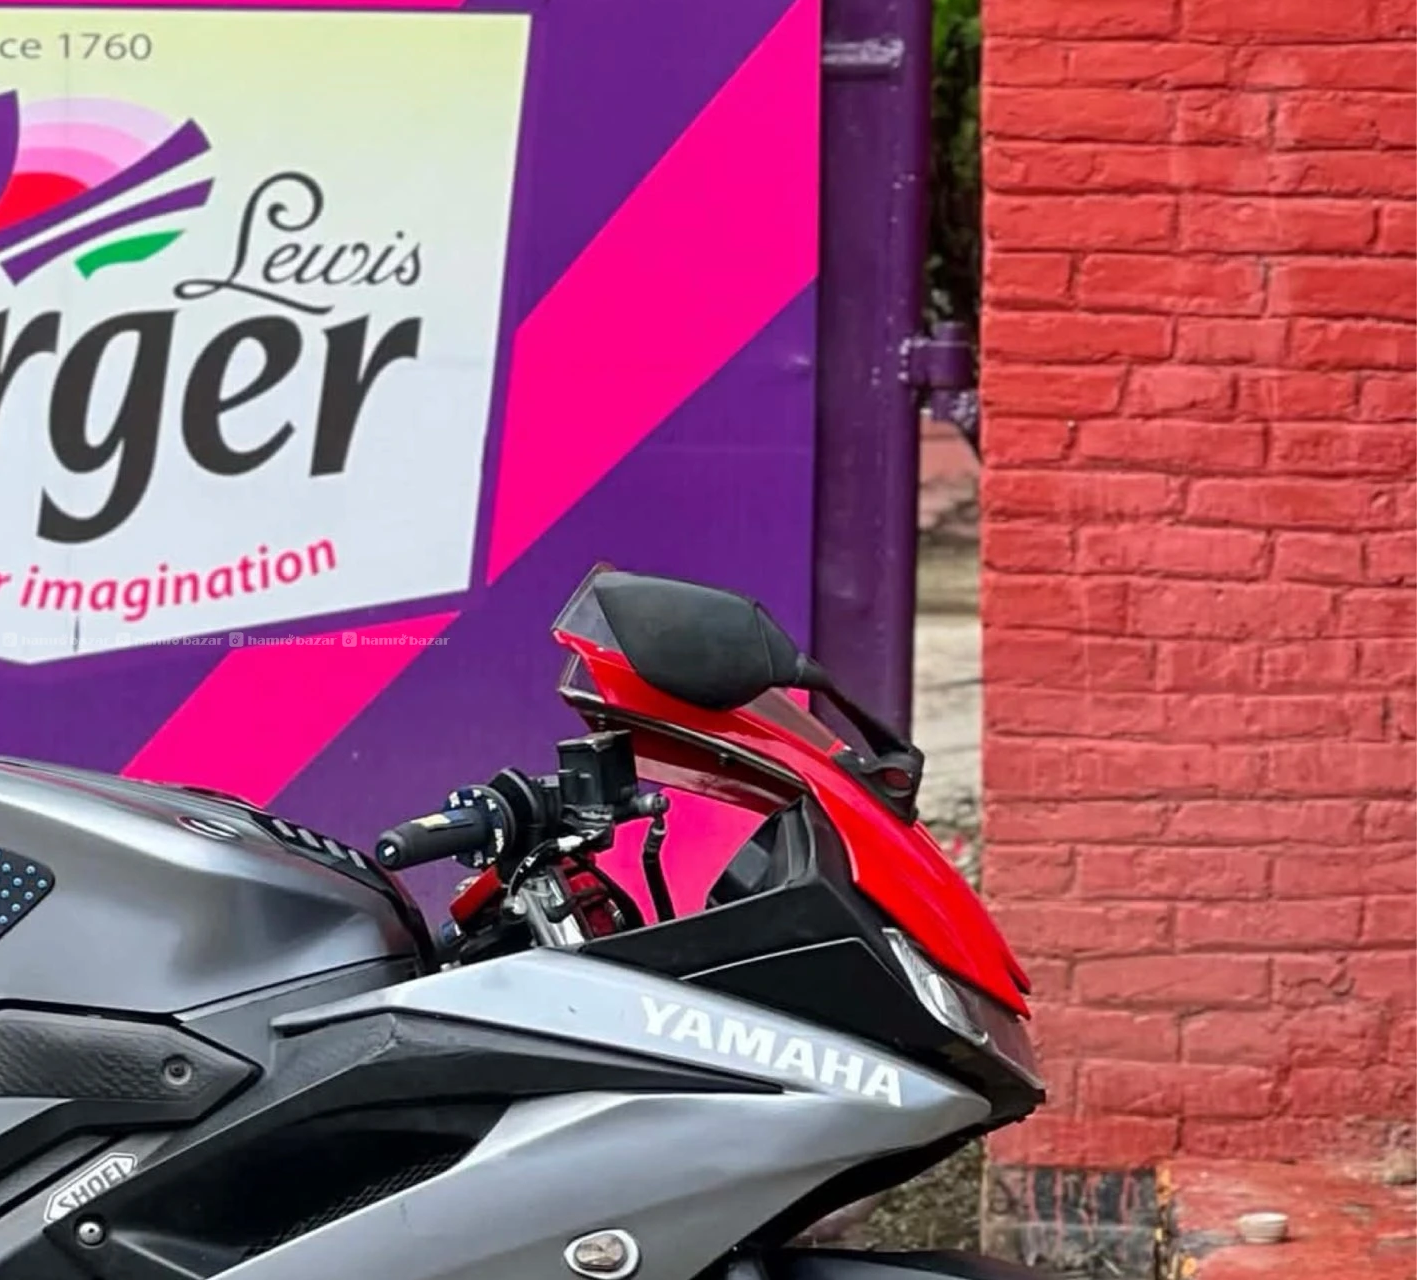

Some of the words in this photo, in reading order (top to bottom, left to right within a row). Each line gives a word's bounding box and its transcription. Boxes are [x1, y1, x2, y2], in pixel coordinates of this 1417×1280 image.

[60, 32, 152, 61] 1760
[173, 172, 422, 315] Lewis
[19, 538, 337, 623] imagination
[640, 992, 904, 1108] YAMAHA
[57, 1160, 128, 1211] SHOEI
